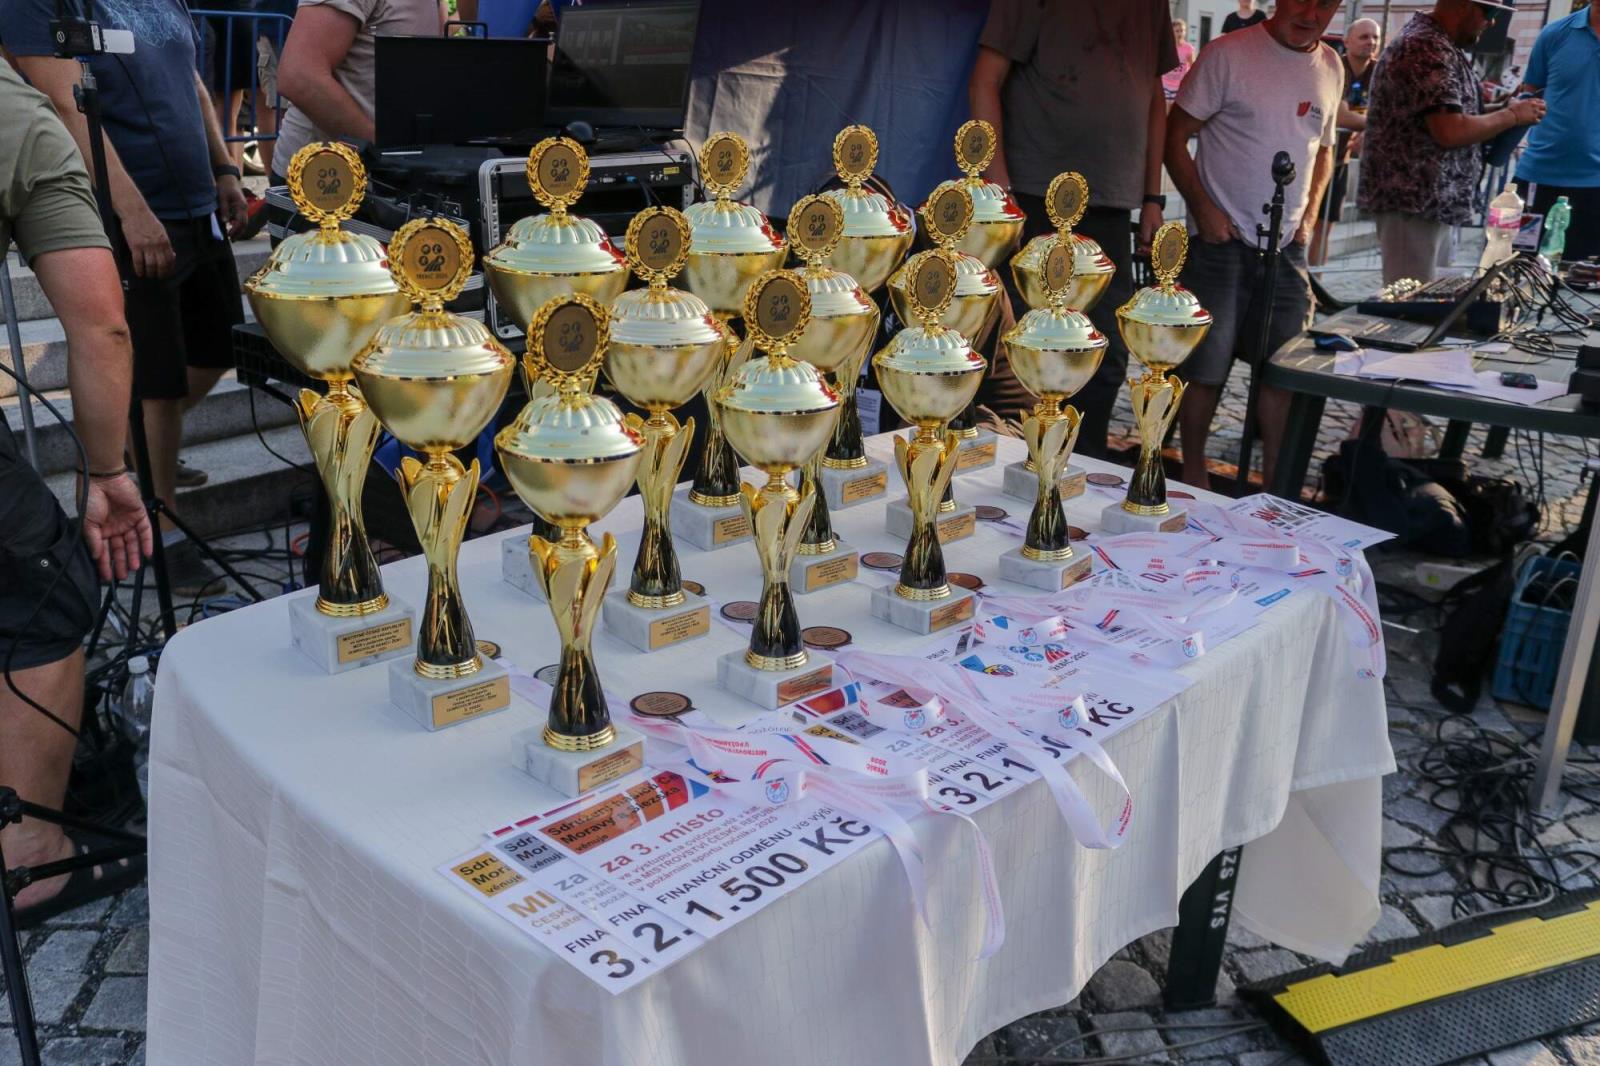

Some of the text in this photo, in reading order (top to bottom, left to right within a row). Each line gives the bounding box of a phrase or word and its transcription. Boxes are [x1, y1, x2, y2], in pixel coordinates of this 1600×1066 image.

[1088, 699, 1135, 728] Kč
[560, 815, 616, 844] Moravy
[600, 854, 634, 874] za
[630, 842, 660, 856] 3.
[656, 860, 732, 905] FINANČNÍ
[730, 829, 793, 865] ODMĚNU
[686, 815, 871, 922] 1.500 Kč
[553, 873, 589, 892] za
